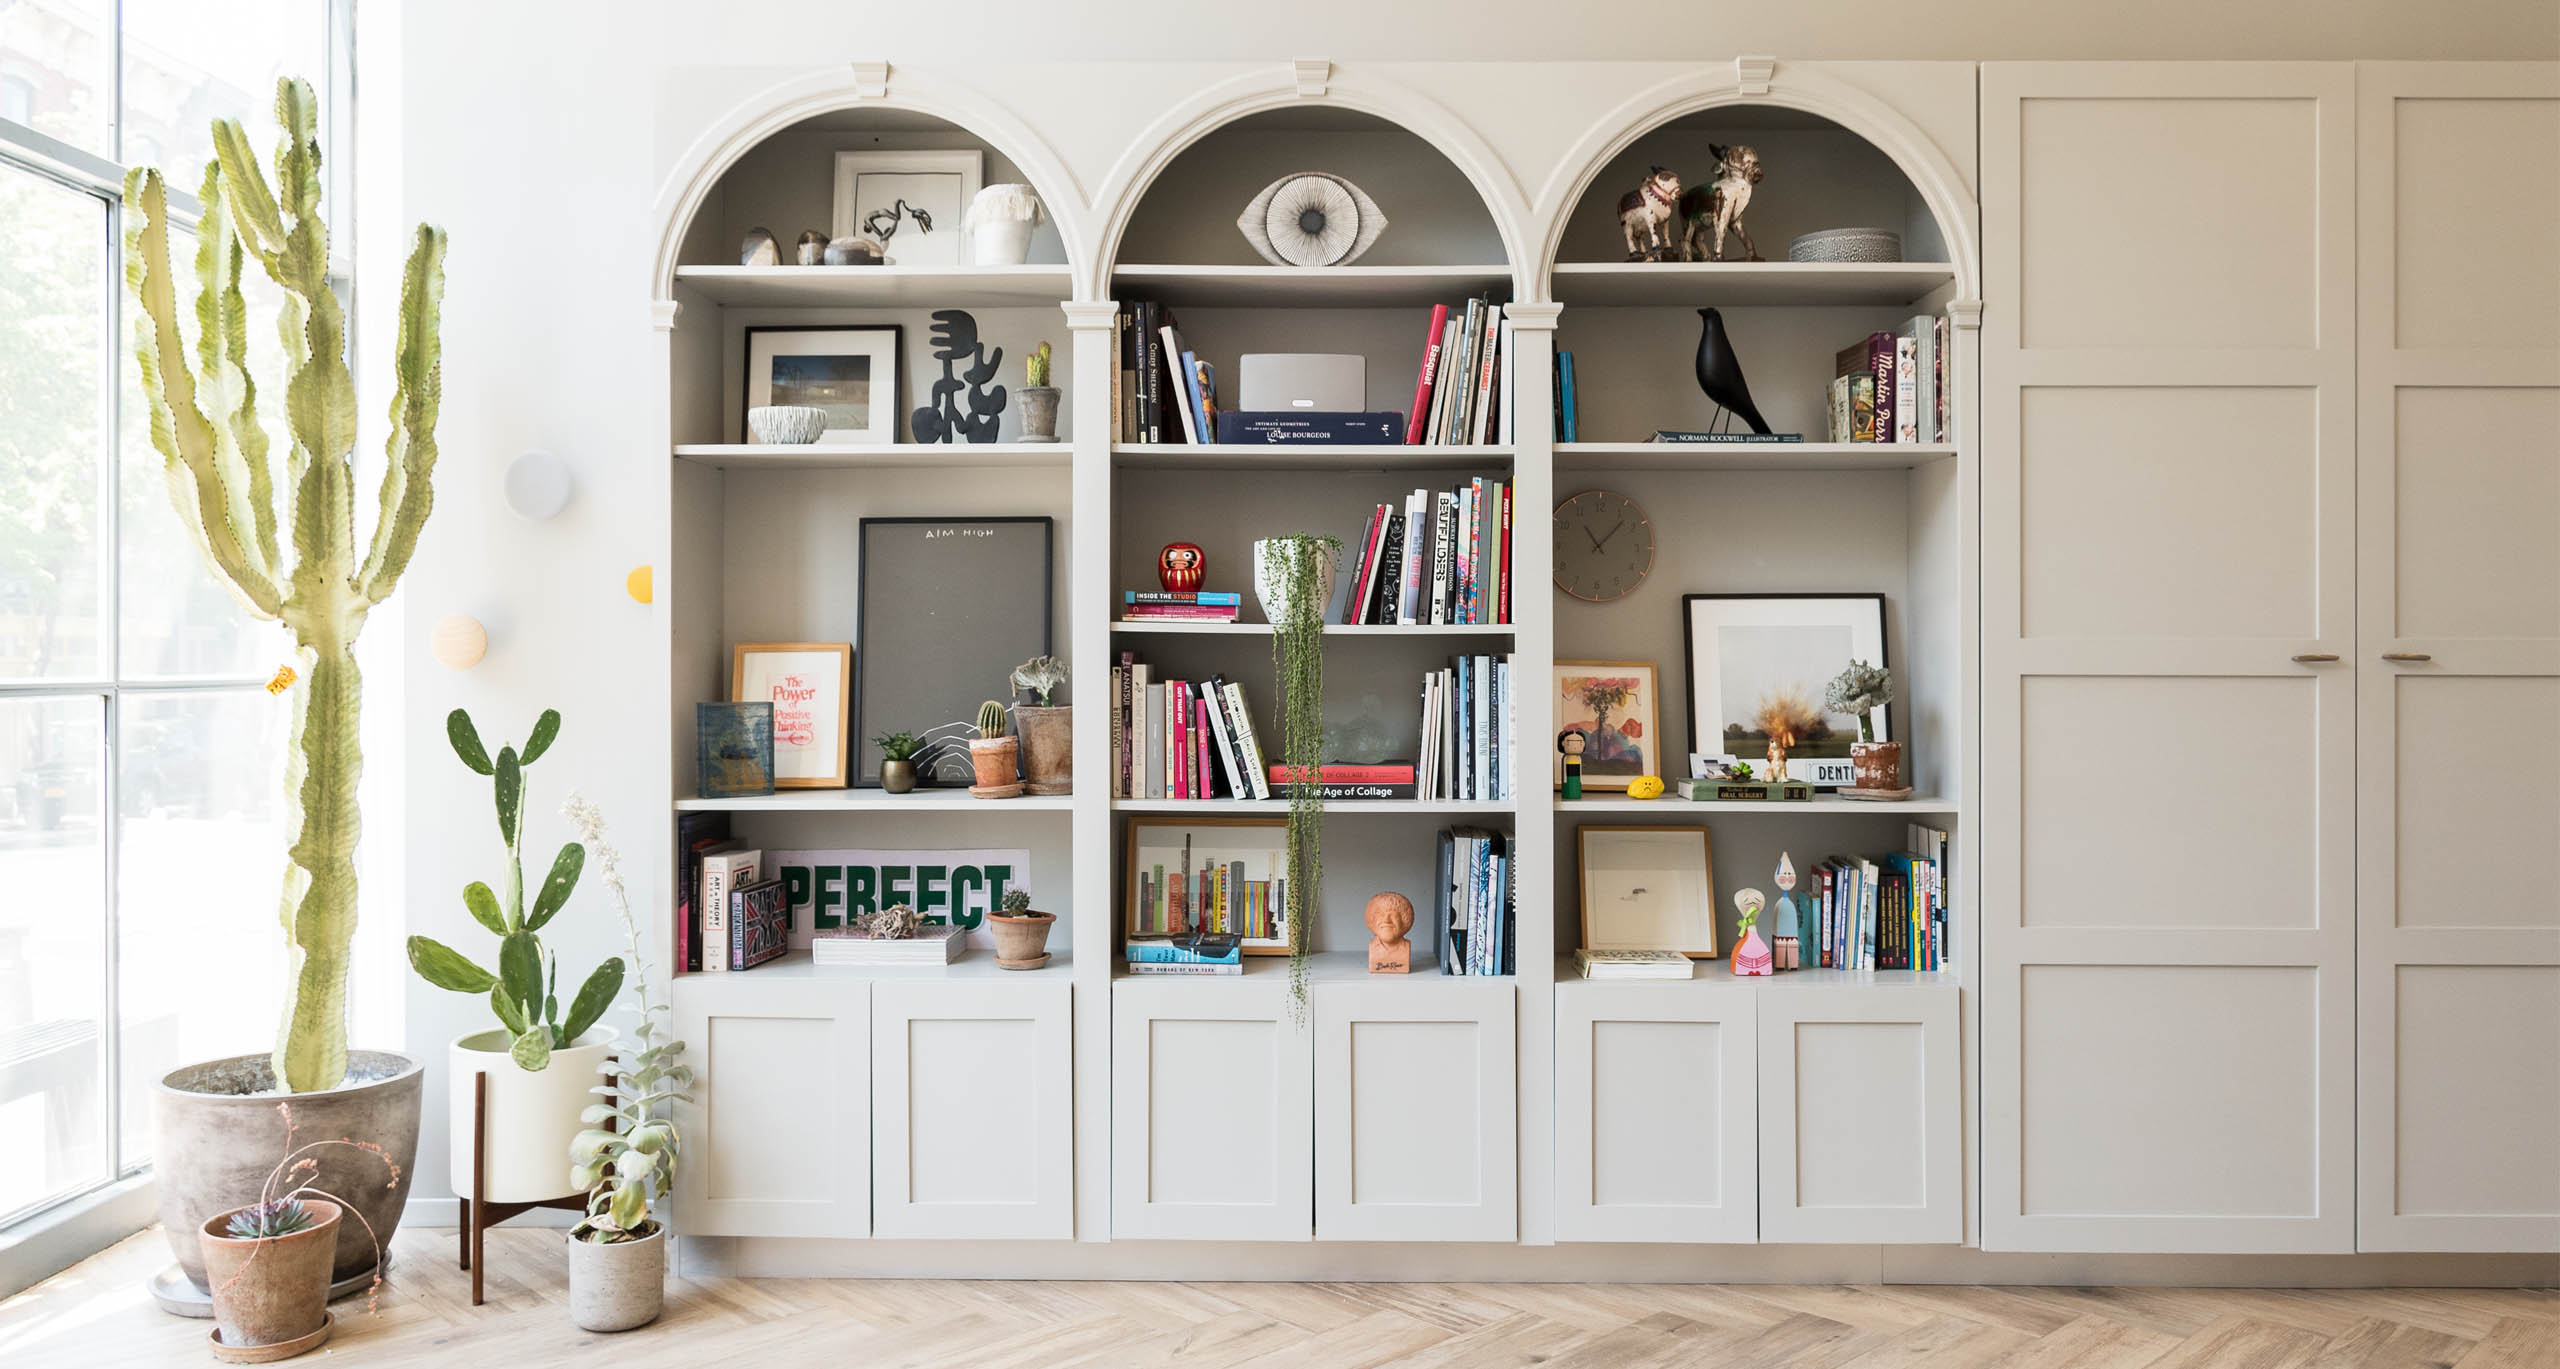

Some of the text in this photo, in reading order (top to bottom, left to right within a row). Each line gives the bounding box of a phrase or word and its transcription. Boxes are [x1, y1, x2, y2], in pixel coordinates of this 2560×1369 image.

[1149, 343, 1158, 404] Cindy Sherman
[1424, 344, 1440, 386] Basquiat
[1874, 352, 1893, 443] Martin Parr
[1266, 431, 1331, 439] LOUISE BOURGEOIS
[925, 529, 994, 539] AIM HIGH
[1436, 498, 1449, 582] BEAUTIFUL LOSERS
[784, 676, 803, 688] The
[1123, 661, 1131, 706] EL ANATSUI
[773, 685, 816, 701] Power
[775, 709, 811, 720] Positive
[774, 720, 812, 732] Thinking
[1244, 738, 1254, 757] DAVID
[1249, 758, 1262, 786] SHRIGLEY
[1323, 787, 1342, 798] Age
[1344, 786, 1355, 796] of
[1357, 787, 1393, 798] Collage
[735, 870, 750, 888] ART
[780, 865, 1011, 930] PERFECT
